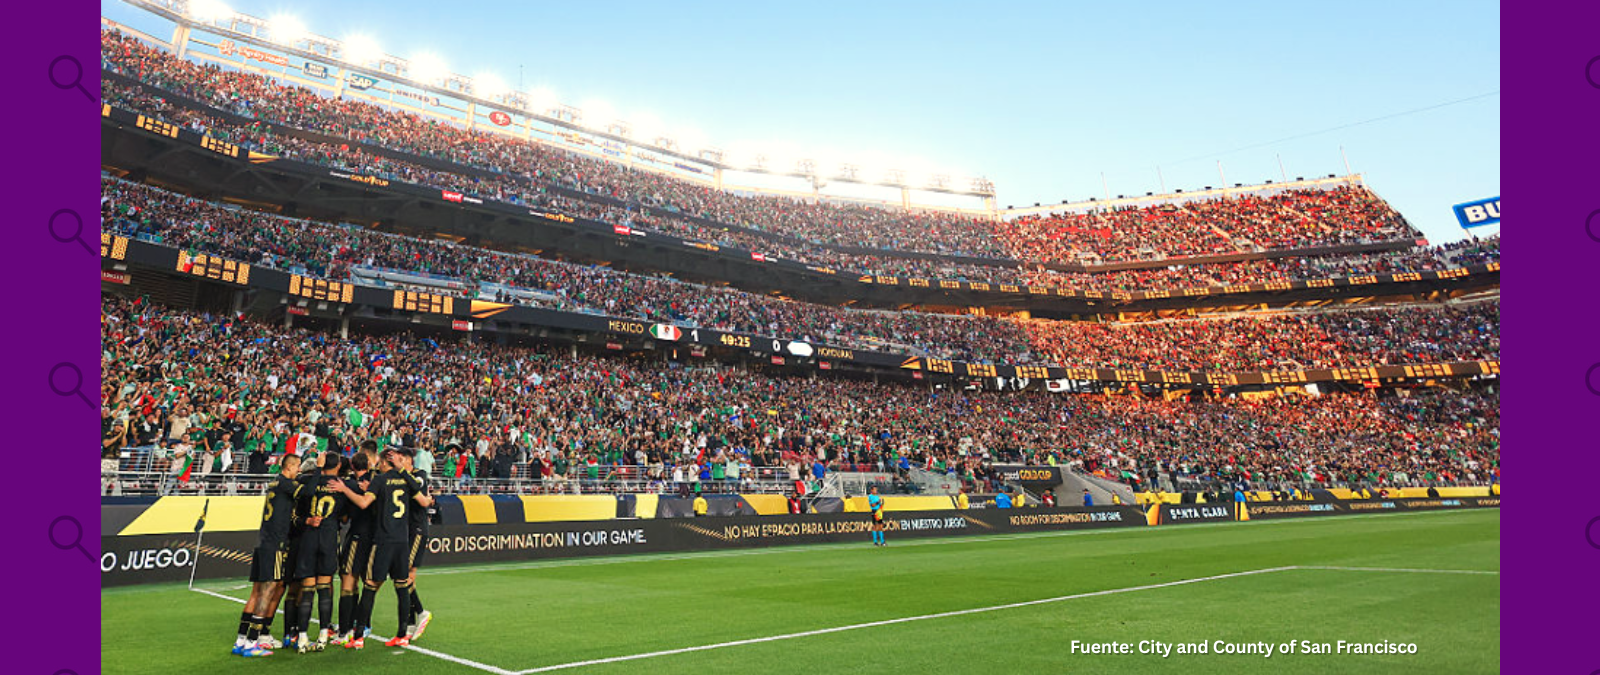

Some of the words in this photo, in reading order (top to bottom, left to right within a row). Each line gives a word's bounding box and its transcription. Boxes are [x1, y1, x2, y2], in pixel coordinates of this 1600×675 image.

[608, 320, 644, 334] MEXICO
[690, 329, 699, 342] 1
[772, 340, 781, 351] 0
[311, 495, 335, 519] 10
[392, 489, 405, 518] 5
[1202, 506, 1228, 518] CLARA
[425, 537, 450, 553] OR
[454, 532, 563, 552] DISCRIMINATION
[567, 531, 579, 546] IN
[582, 530, 607, 546] OUR
[610, 528, 647, 544] GAME.
[725, 525, 740, 539] NO
[743, 524, 760, 538] HAY
[762, 523, 800, 537] ESPACIO
[801, 522, 823, 534] PARA
[825, 522, 836, 533] LA
[121, 548, 193, 571] JUEGO.
